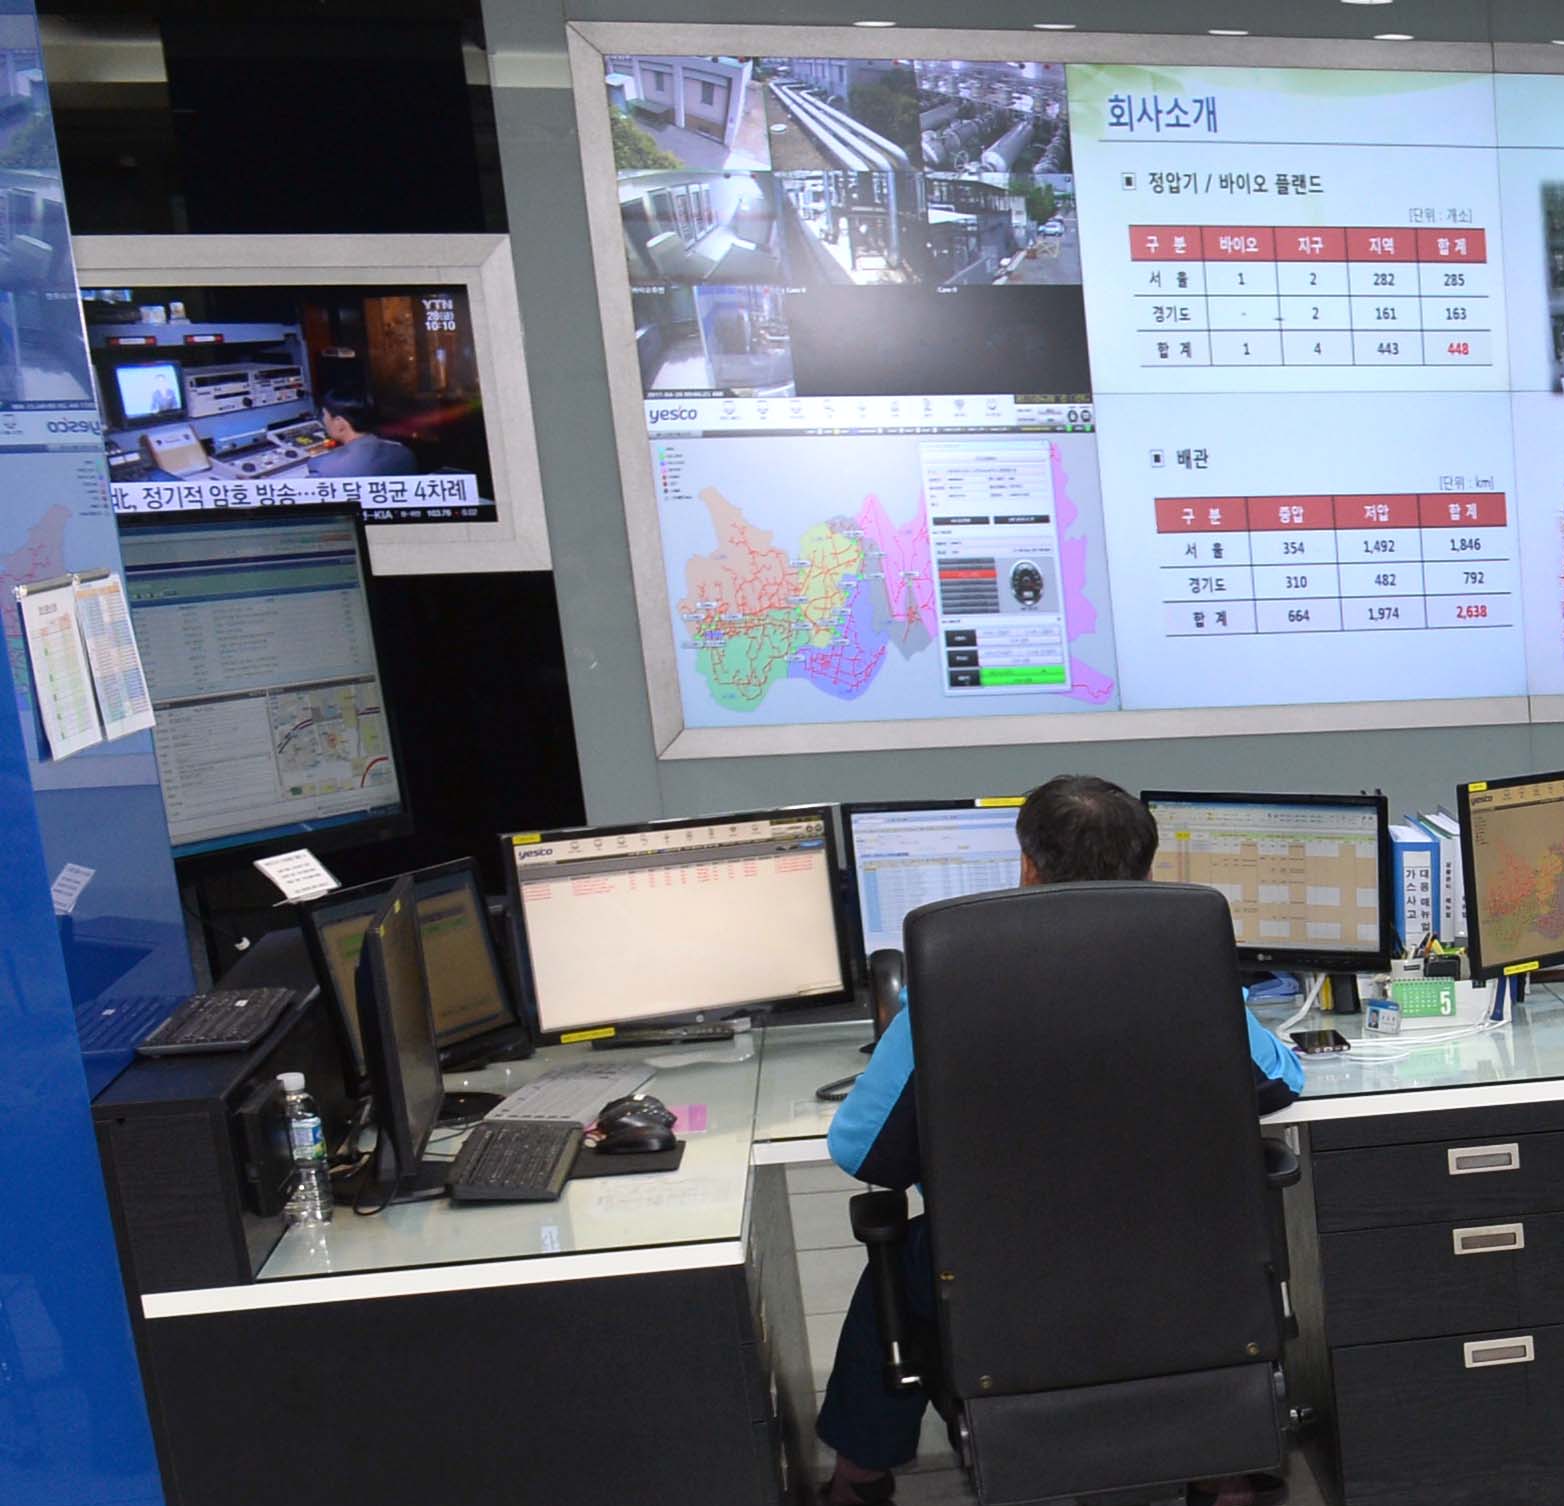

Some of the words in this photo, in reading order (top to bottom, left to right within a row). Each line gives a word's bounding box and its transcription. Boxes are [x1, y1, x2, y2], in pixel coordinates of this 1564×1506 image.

[1107, 94, 1219, 133] 회사소개
[1148, 172, 1198, 195] 정압기
[1219, 172, 1268, 195] 바이오
[1219, 236, 1259, 254] 바이오
[1298, 237, 1324, 254] 지구
[1368, 237, 1395, 255] 지역
[1237, 273, 1246, 286] 1
[1309, 273, 1318, 286] 2
[1373, 273, 1396, 286] 282
[1443, 273, 1465, 287] 285
[422, 299, 453, 310] YTN
[1152, 305, 1192, 323] 경기도
[1311, 307, 1320, 320] 2
[1375, 307, 1397, 321] 161
[1445, 307, 1468, 321] 163
[424, 320, 456, 331] 10:10
[1242, 343, 1251, 356] 1
[1313, 342, 1322, 355] 4
[1377, 342, 1399, 356] 443
[1447, 342, 1470, 356] 448
[1176, 448, 1209, 471] 배관
[142, 486, 204, 511] 정기적
[209, 484, 252, 509] 암호
[343, 482, 363, 502] 달
[368, 480, 409, 504] 평균
[414, 479, 467, 502] 4차례
[1364, 503, 1391, 523] 저압
[1282, 540, 1305, 555] 354
[1363, 538, 1395, 555] 1,492
[1449, 537, 1482, 552] 1,846
[1188, 576, 1227, 594] 경기도
[1285, 574, 1308, 589] 310
[1374, 572, 1397, 587] 482
[1463, 570, 1485, 585] 792
[1287, 608, 1310, 624] 664
[1367, 606, 1400, 622] 1,974
[1456, 604, 1488, 620] 2,638
[1406, 869, 1417, 920] 가스사고
[1440, 990, 1453, 1016] 5
